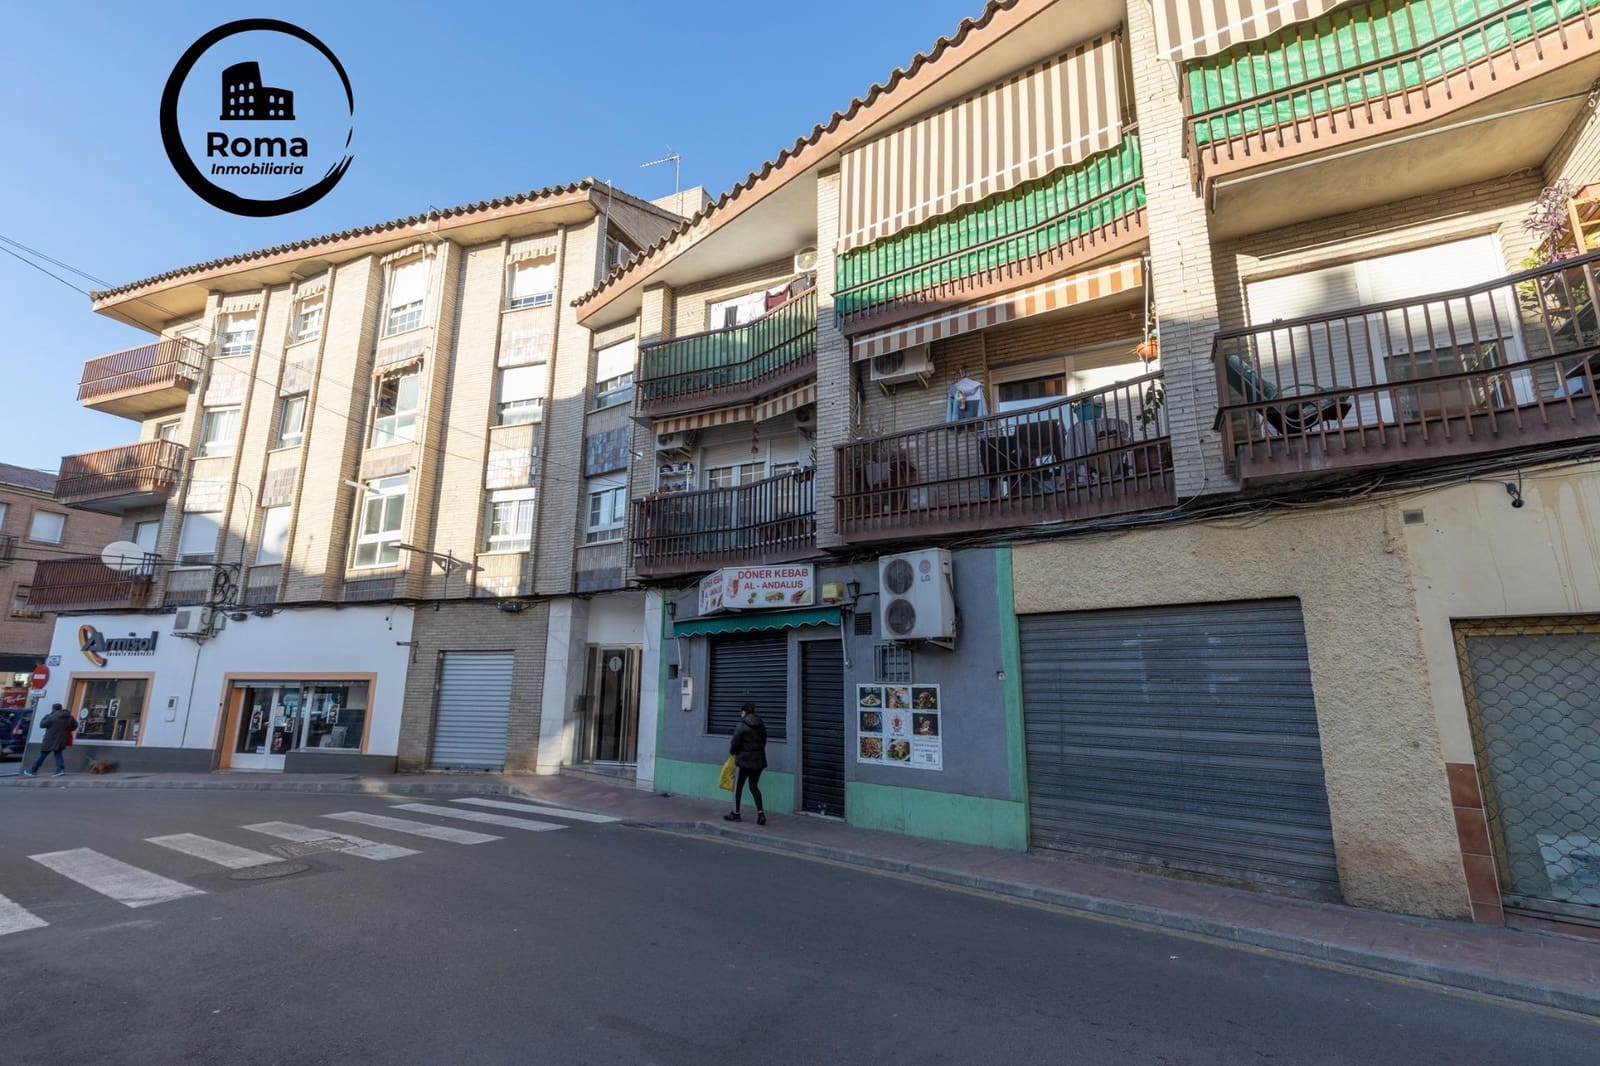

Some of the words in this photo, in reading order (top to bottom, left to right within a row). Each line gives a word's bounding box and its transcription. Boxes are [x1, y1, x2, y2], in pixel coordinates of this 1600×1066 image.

[774, 568, 809, 578] KEBAB
[920, 574, 931, 582] LG
[744, 582, 755, 590] AL
[762, 580, 803, 589] ANDALUS
[80, 630, 159, 652] Armisol
